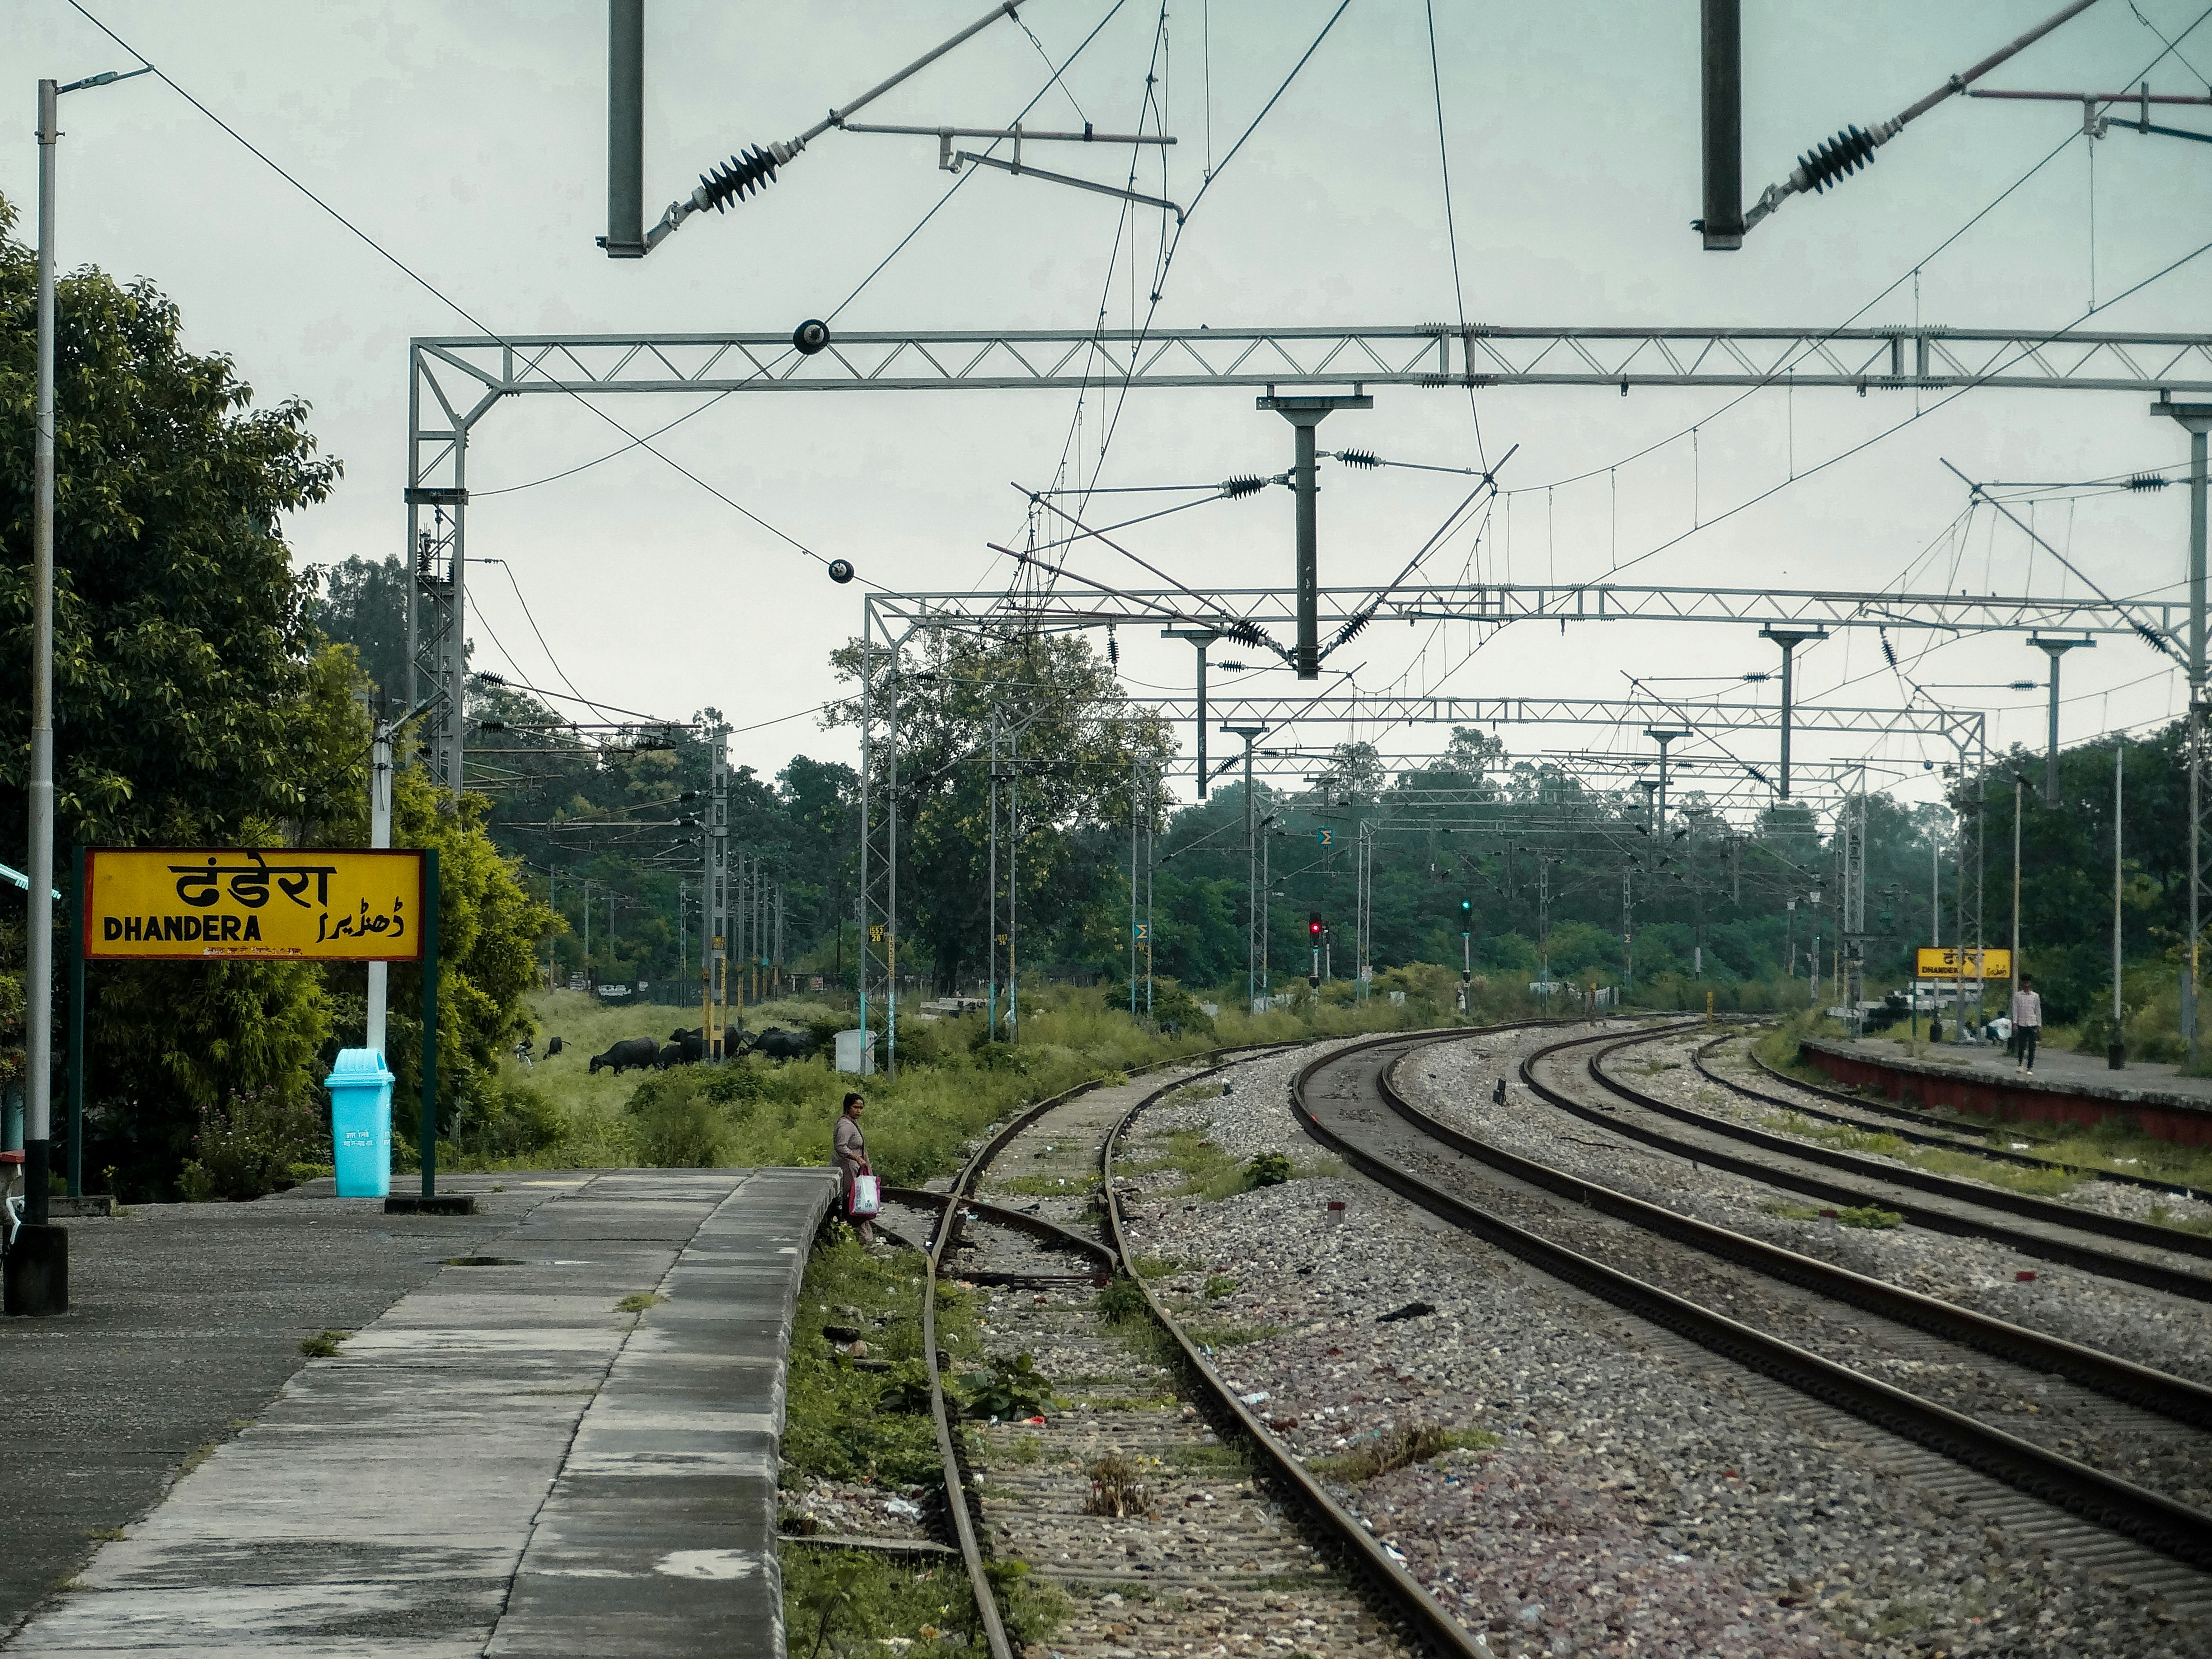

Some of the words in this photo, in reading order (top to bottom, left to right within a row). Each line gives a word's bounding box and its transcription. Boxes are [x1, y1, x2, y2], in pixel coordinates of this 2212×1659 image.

[167, 851, 337, 908] ढंडेरा
[104, 915, 262, 941] DHANDERA
[315, 896, 404, 943] ڈھنڈیرا
